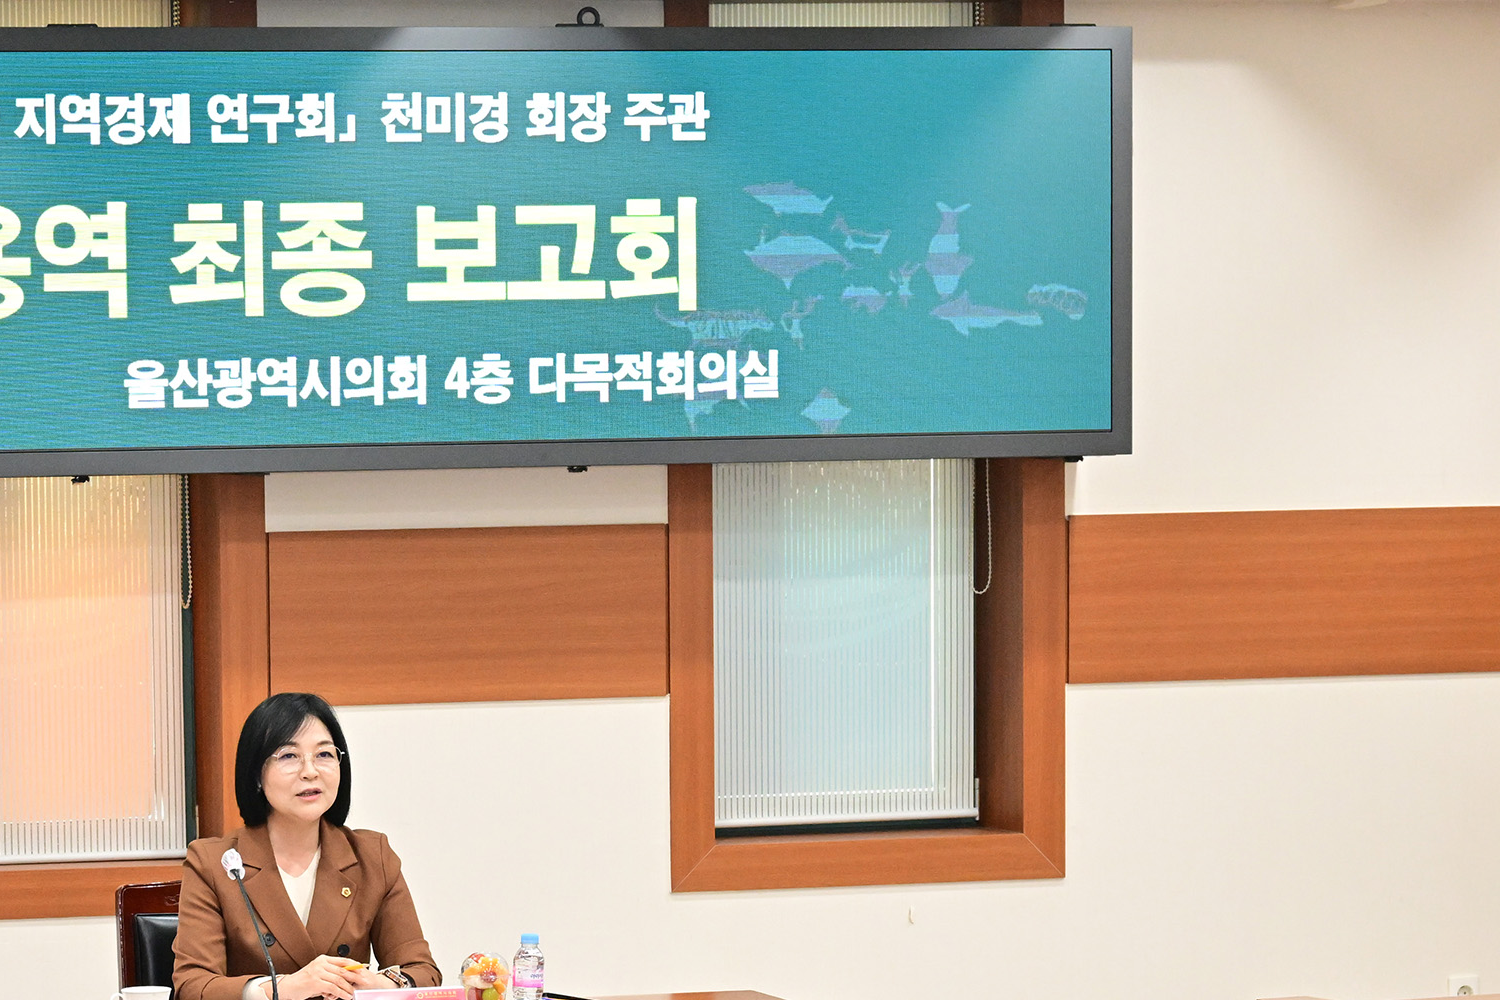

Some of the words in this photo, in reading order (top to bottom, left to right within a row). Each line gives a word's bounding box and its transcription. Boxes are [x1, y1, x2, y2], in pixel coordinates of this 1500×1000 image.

[14, 93, 190, 144] 지역경제
[381, 92, 508, 143] 천미경
[526, 92, 611, 142] 회장
[624, 92, 710, 141] 주관
[170, 201, 372, 317] 최종
[407, 197, 697, 311] 보고회
[124, 355, 426, 408] 울산광역시의회
[445, 354, 513, 404] 4층
[530, 350, 778, 402] 다목적회의실
